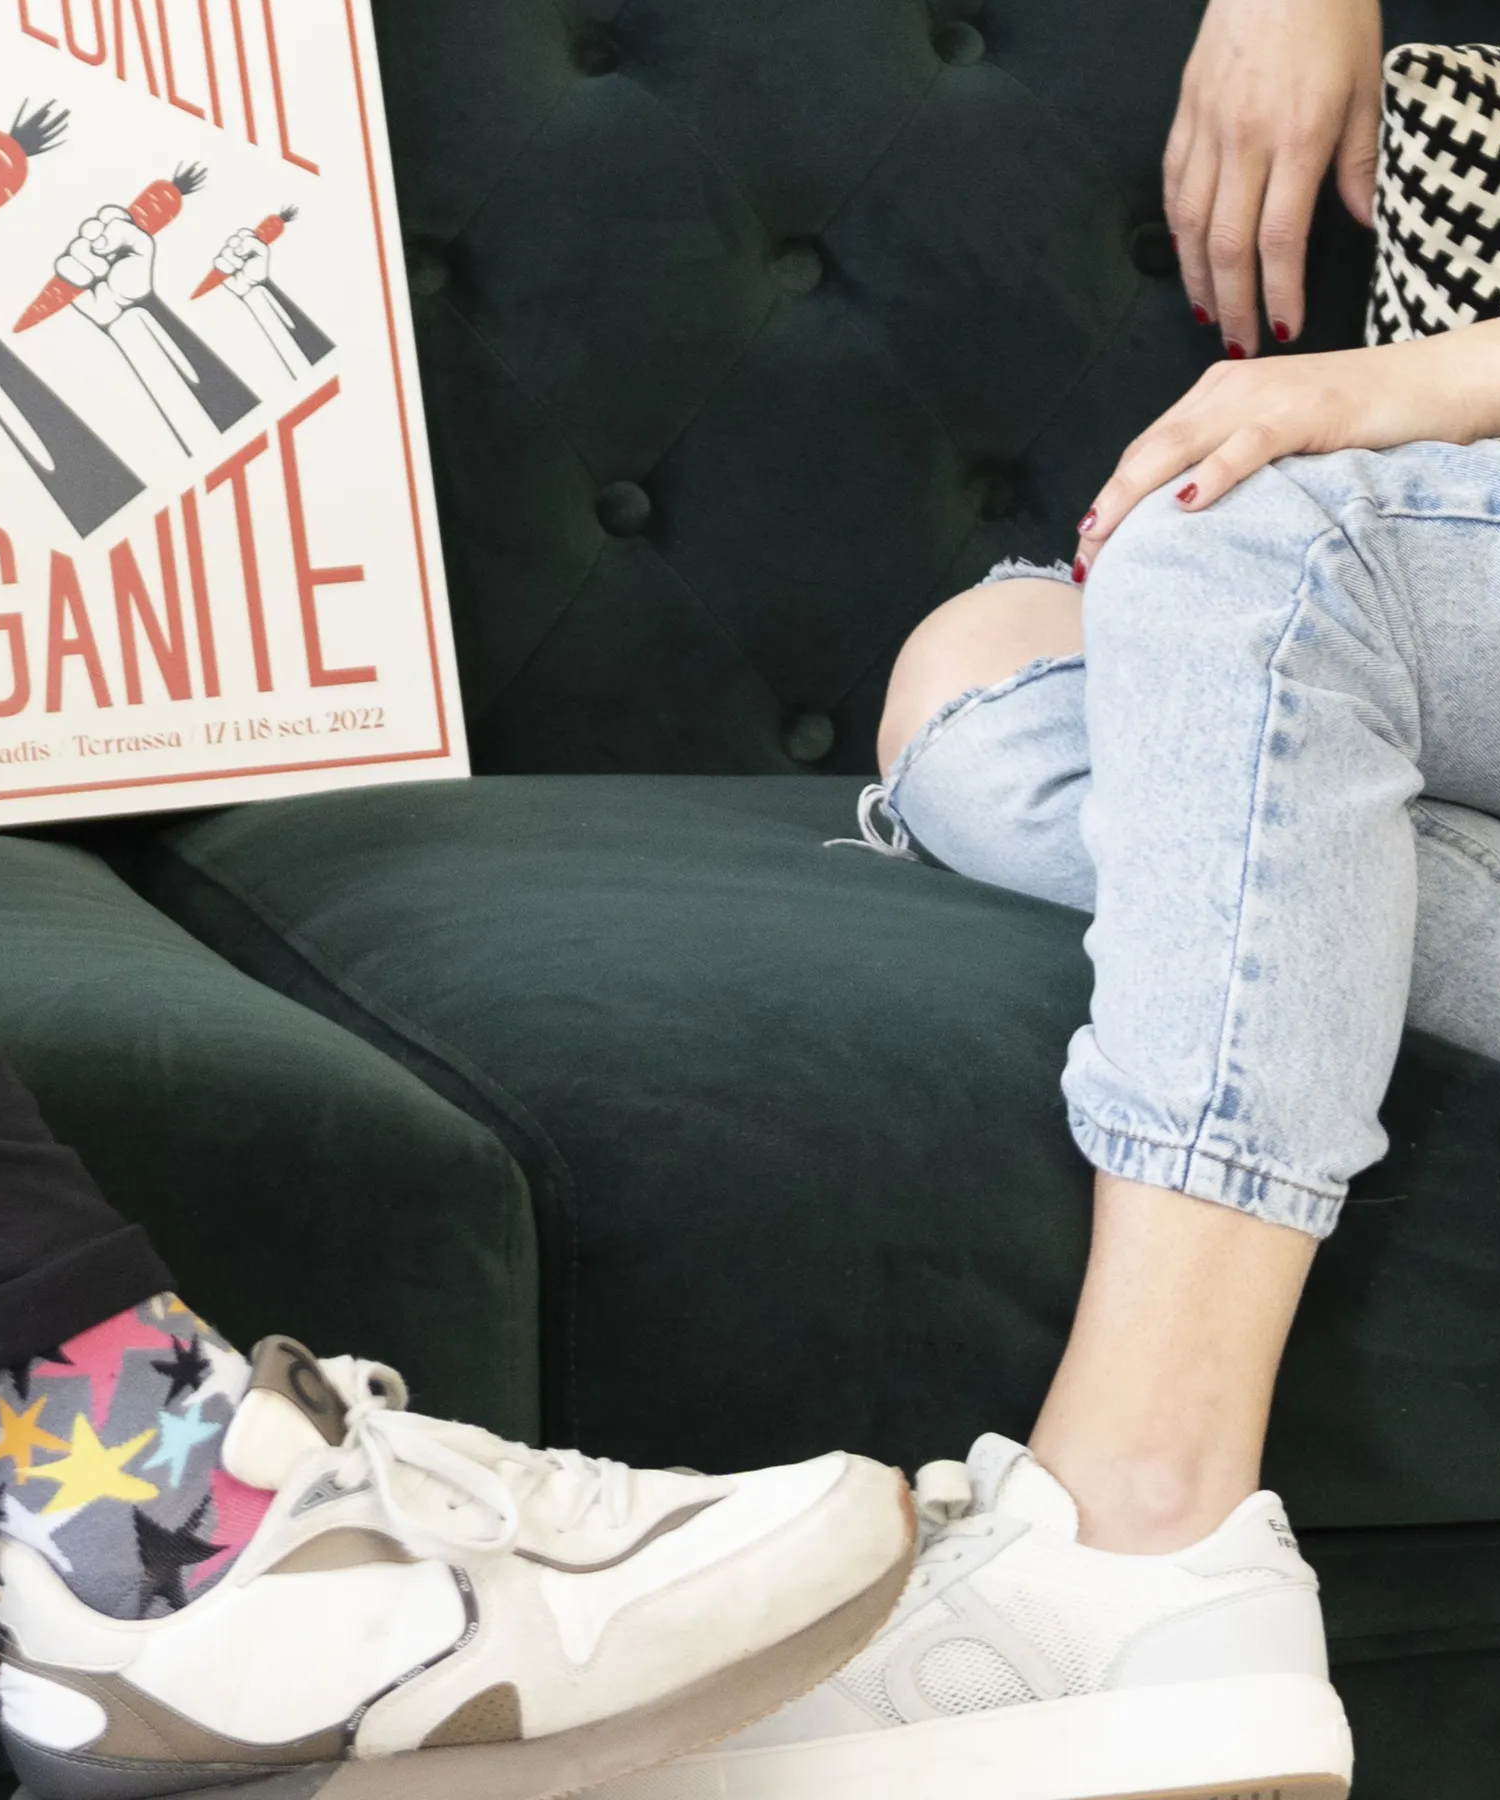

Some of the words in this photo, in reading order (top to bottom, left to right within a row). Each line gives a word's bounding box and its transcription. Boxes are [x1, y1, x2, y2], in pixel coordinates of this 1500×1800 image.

[73, 732, 182, 759] Terrassa
[203, 722, 225, 745] 17
[249, 718, 274, 742] 18
[327, 706, 386, 734] 2022
